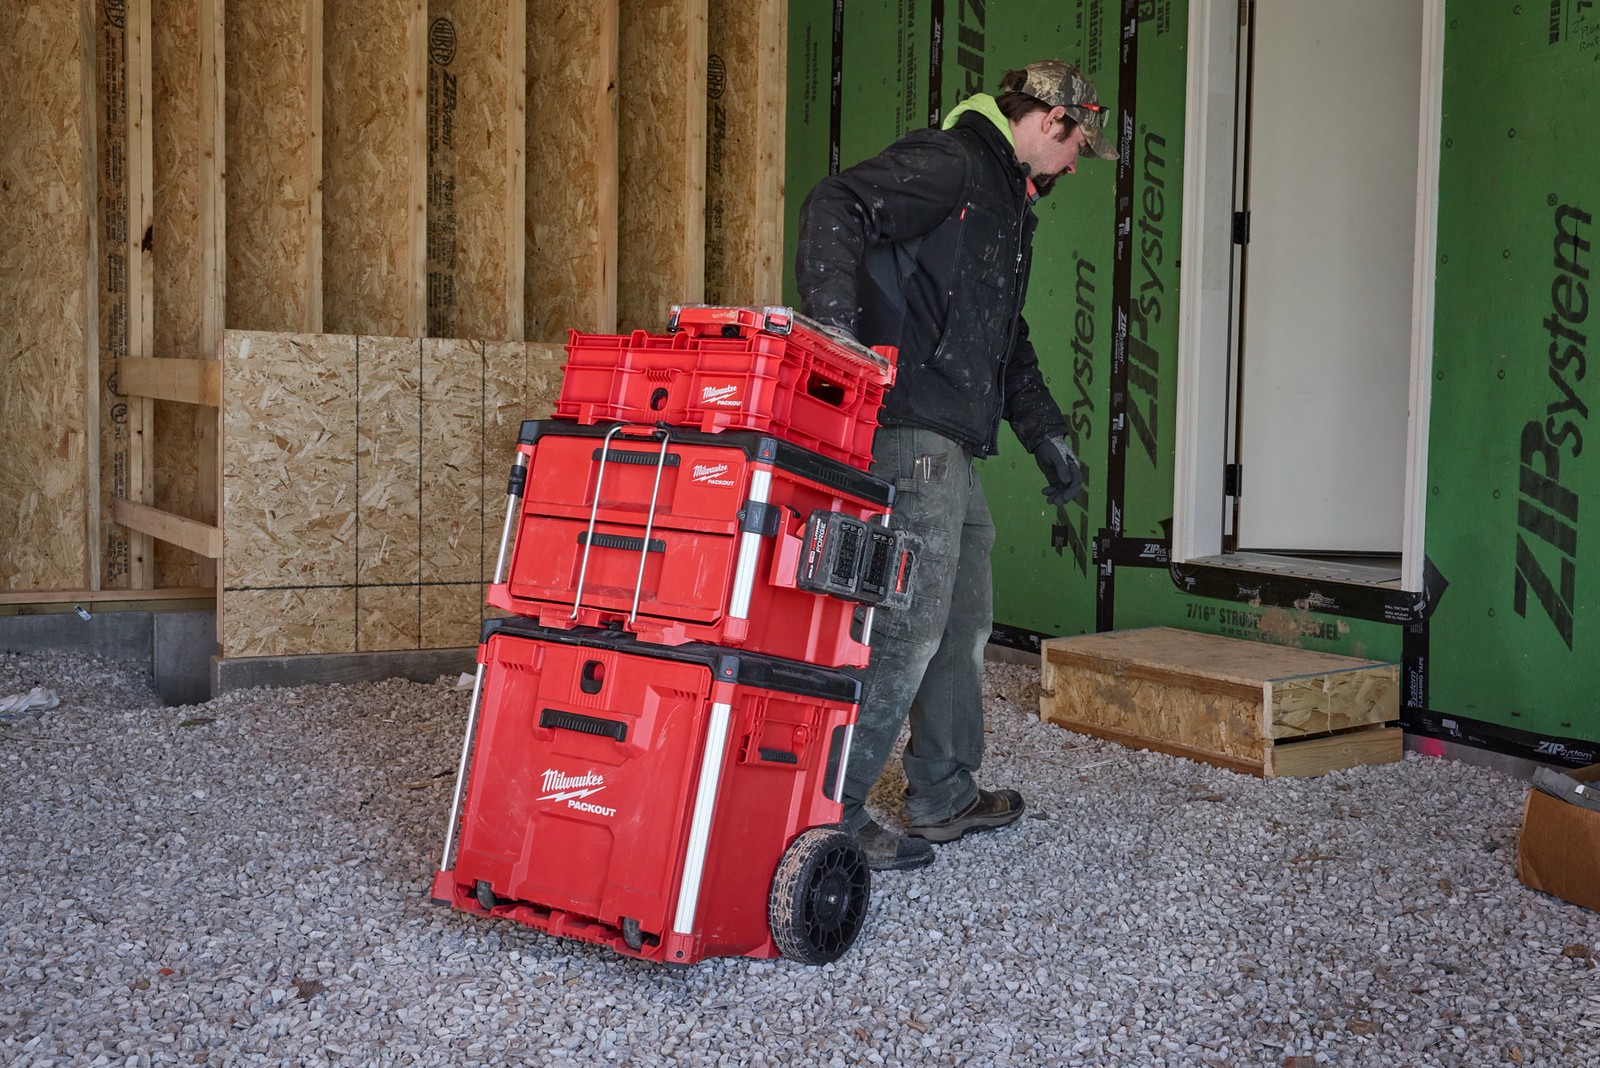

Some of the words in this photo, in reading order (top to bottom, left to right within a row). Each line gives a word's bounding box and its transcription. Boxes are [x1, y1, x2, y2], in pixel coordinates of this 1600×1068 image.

[1156, 6, 1165, 37] YEAR
[431, 21, 455, 63] HUBER
[1088, 0, 1099, 75] STRUCTUR
[905, 42, 915, 122] STRUCTURAL
[702, 384, 738, 400] Milwaukee
[693, 463, 729, 478] Milwaukee
[708, 479, 735, 487] PACKOUT
[816, 522, 827, 553] FORGE
[540, 768, 604, 793] Milwaukee
[567, 799, 617, 817] PACKOUT
